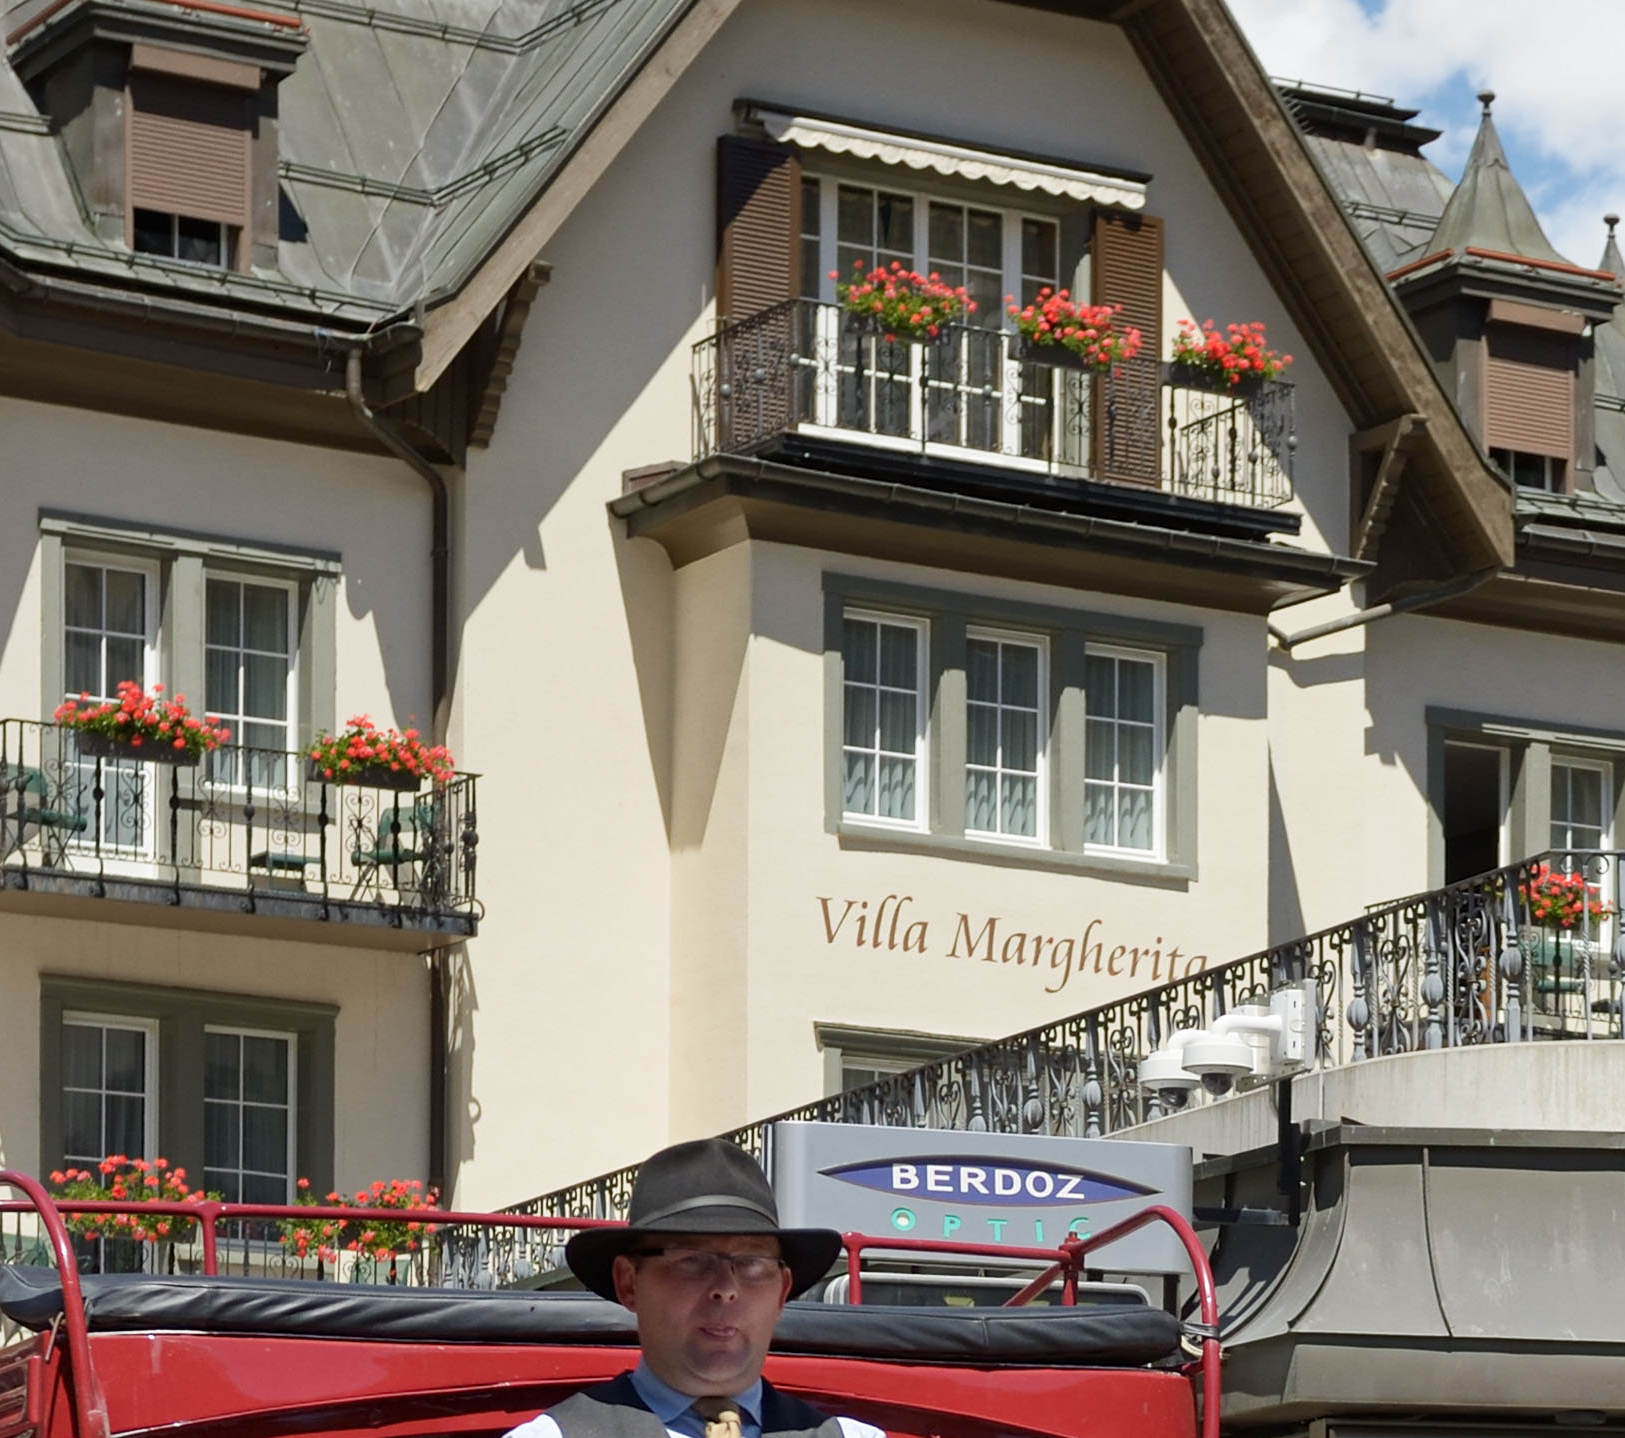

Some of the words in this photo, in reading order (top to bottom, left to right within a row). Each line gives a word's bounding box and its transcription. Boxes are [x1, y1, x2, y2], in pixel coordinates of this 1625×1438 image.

[815, 894, 929, 955] Villa
[946, 911, 1209, 994] Margherita
[891, 1162, 1086, 1201] BERDOZ
[890, 1206, 1093, 1244] OPTIC
